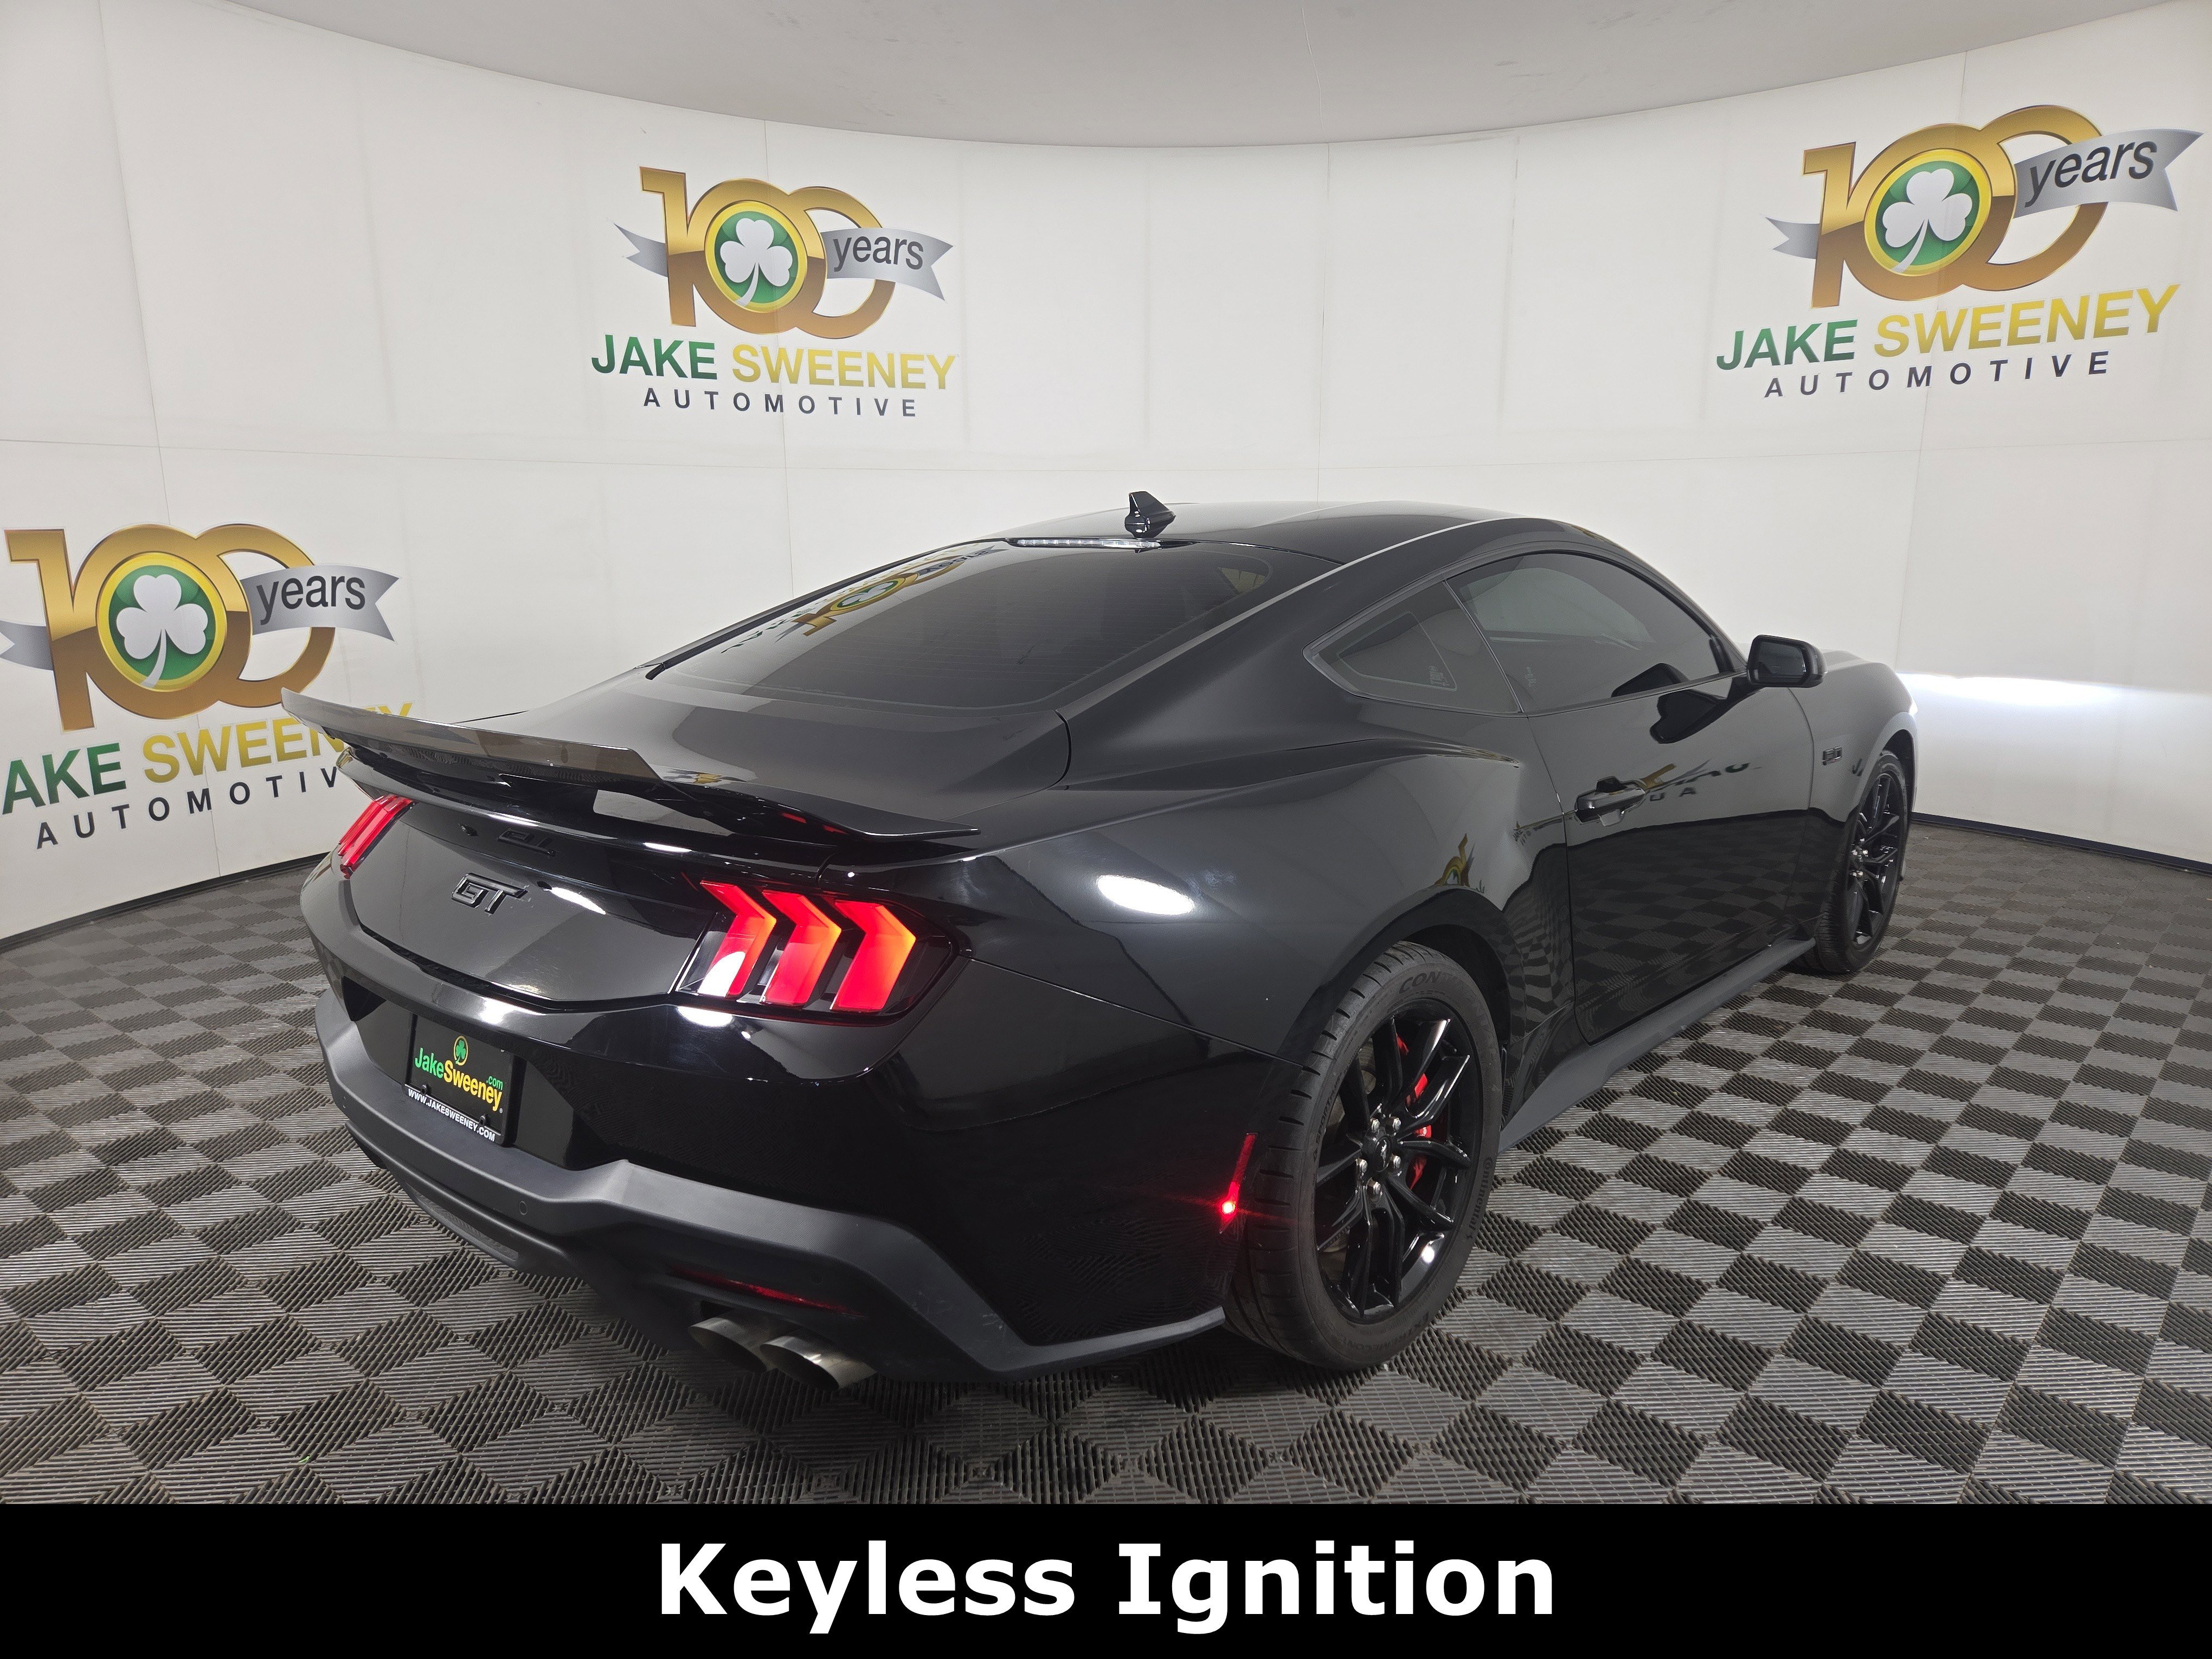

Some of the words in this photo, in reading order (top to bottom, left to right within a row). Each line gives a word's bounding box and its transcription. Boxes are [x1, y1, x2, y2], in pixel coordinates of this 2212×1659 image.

[2025, 141, 2157, 208] years
[833, 236, 923, 272] years
[1716, 319, 1858, 370] JAKE
[1874, 284, 2180, 357] SWEENEY
[591, 335, 717, 380] JAKE
[732, 344, 956, 390] SWEENEY
[1764, 350, 2108, 398] AUTOMOTIVE
[644, 388, 915, 417] AUTOMOTIVE
[256, 576, 365, 625] years
[2, 742, 126, 814] AKE
[143, 702, 413, 783] SWEE
[36, 766, 337, 850] AUTOMOTIV
[452, 873, 528, 914] GT
[408, 1088, 495, 1142] WWW.JAKESWEENEY.COM
